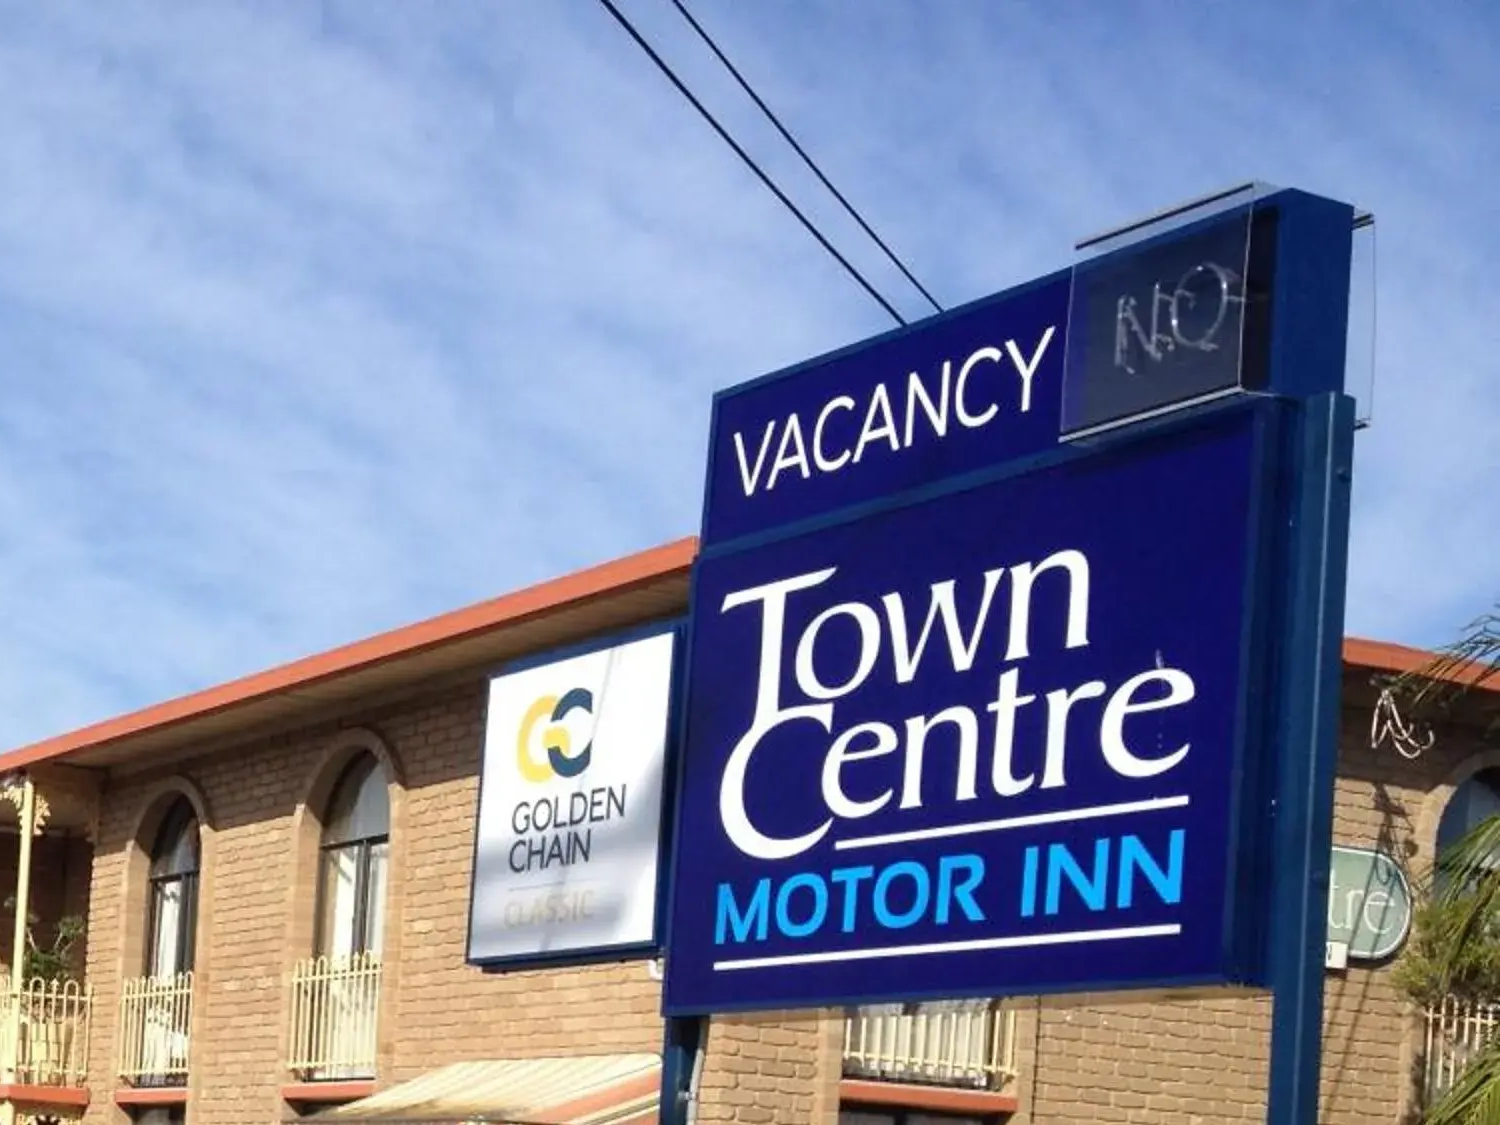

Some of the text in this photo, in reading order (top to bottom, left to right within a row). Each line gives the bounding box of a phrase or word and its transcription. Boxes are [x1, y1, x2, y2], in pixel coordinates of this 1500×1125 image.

[733, 325, 1057, 496] VACANCY
[721, 549, 1089, 720] Town
[511, 784, 627, 834] GOLDEN
[718, 667, 1195, 859] Centre
[508, 829, 592, 873] CHAIN
[714, 829, 1186, 945] MOTOR INN
[1328, 868, 1395, 934] tre
